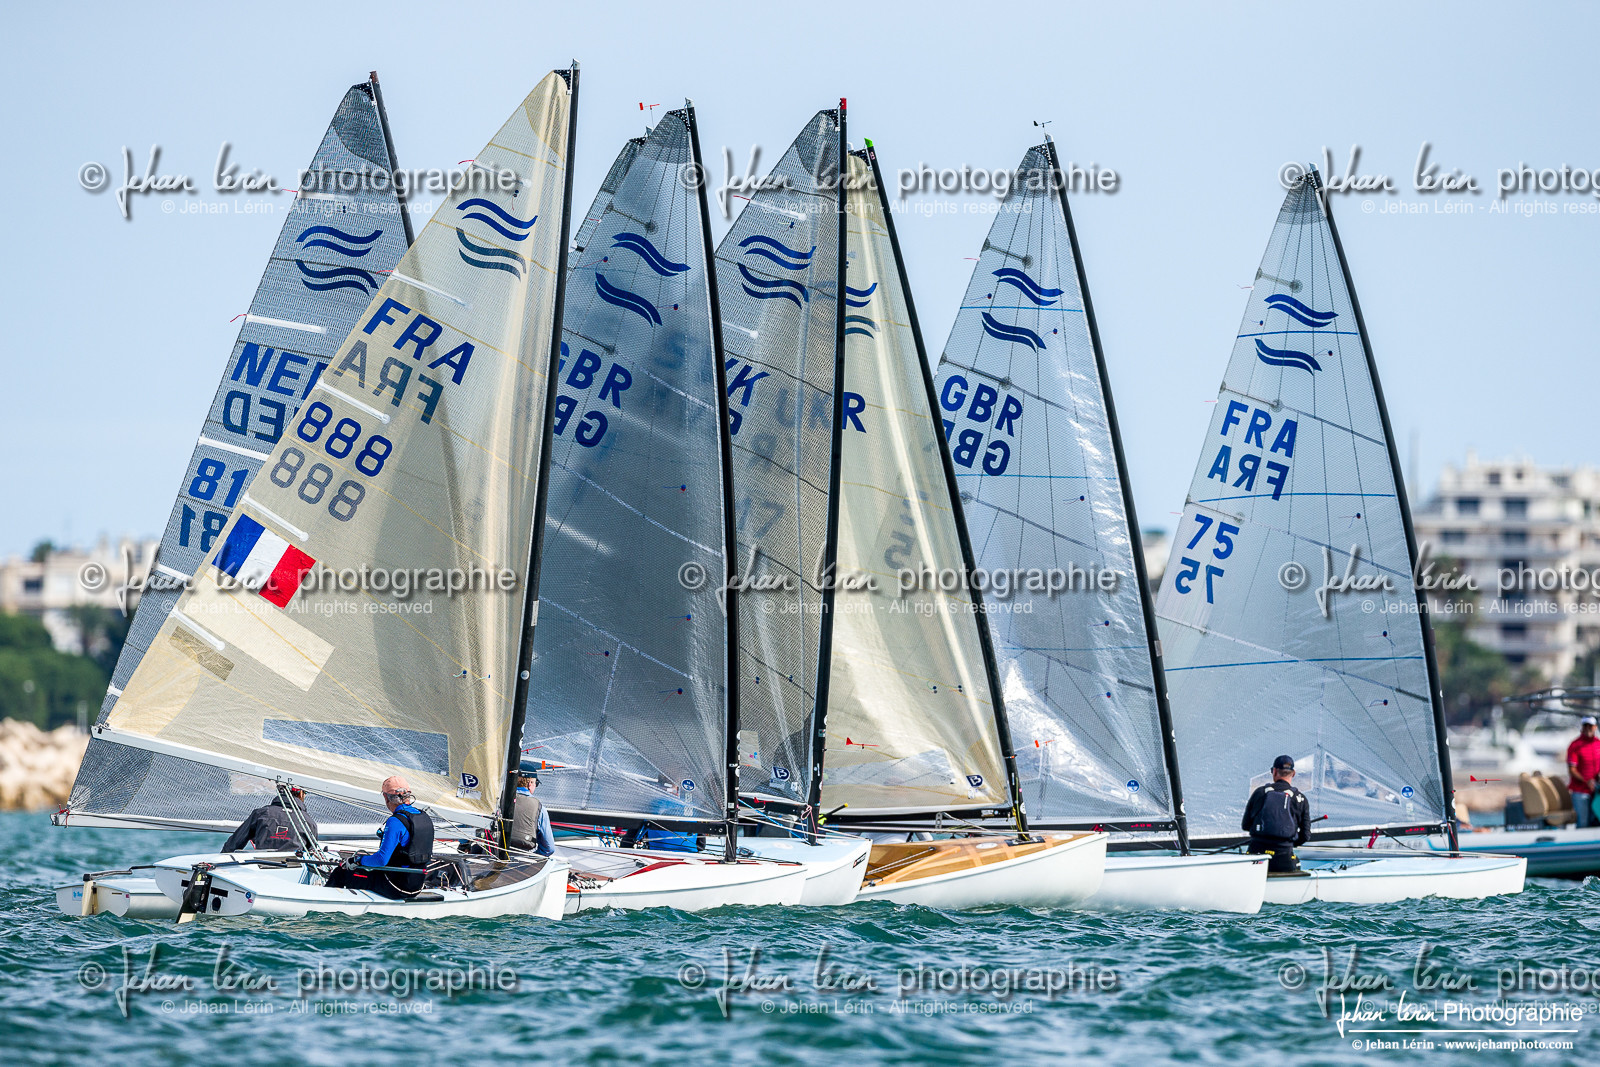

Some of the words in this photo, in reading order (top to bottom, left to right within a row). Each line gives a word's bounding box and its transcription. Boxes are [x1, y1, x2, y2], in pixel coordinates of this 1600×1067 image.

[362, 297, 475, 386] FRA
[940, 375, 1023, 437] GBR
[1220, 400, 1298, 458] FRA
[297, 401, 392, 477] 888
[188, 458, 249, 508] 81
[1187, 513, 1240, 560] 75
